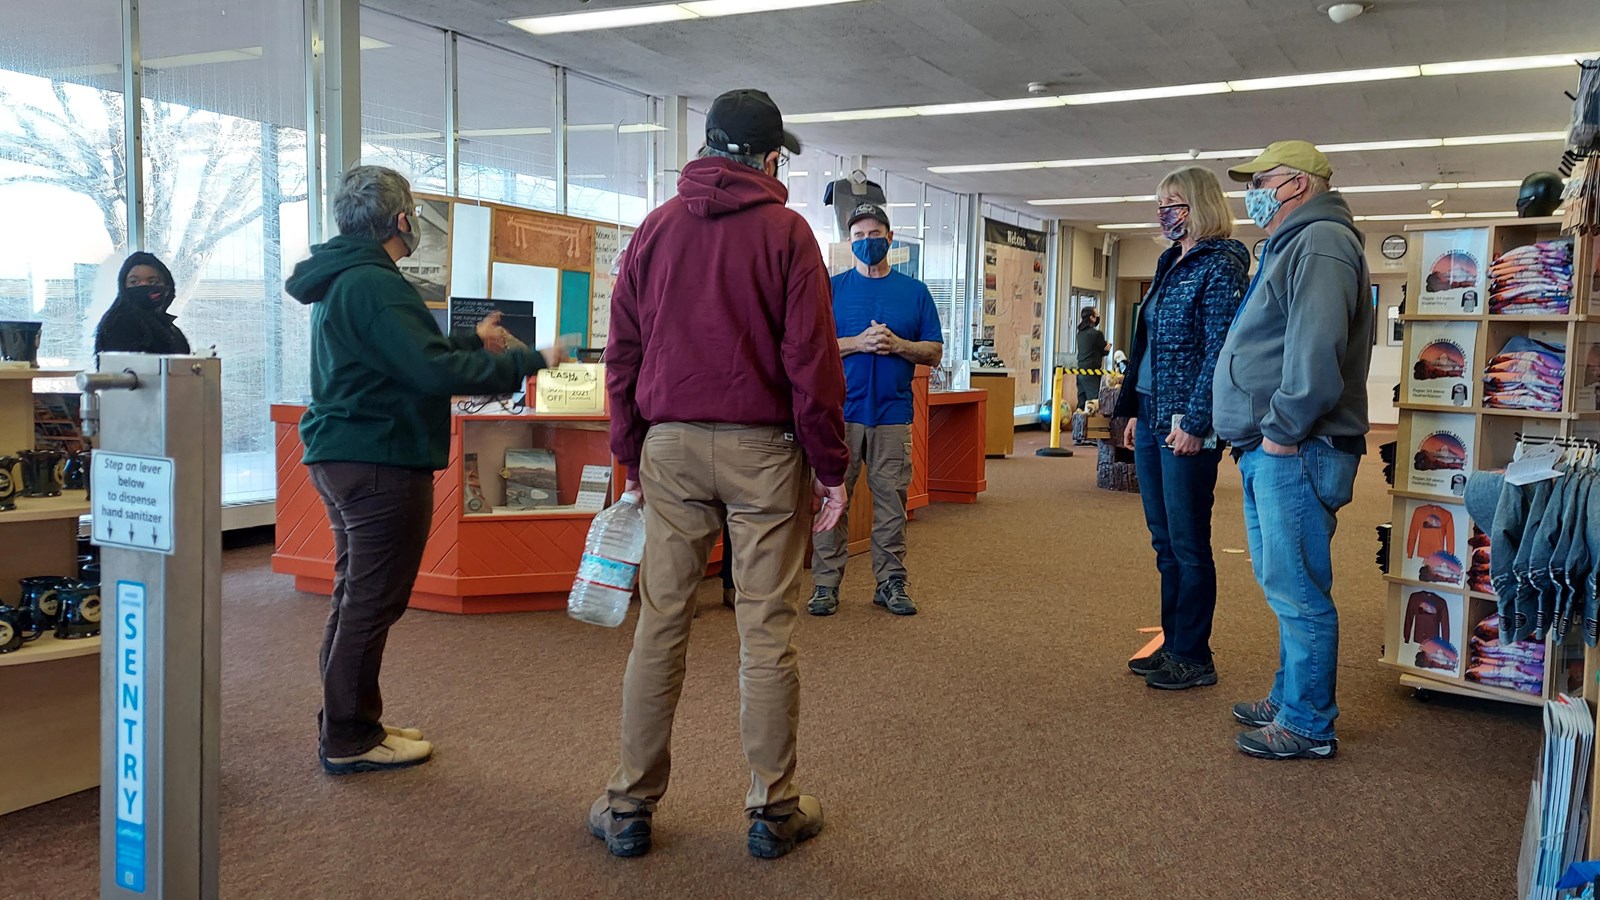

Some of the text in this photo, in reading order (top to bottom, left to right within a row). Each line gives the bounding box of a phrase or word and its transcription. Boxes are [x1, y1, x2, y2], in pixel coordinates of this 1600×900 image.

[104, 458, 162, 474] Step on lever
[118, 475, 145, 488] below
[108, 492, 156, 506] to dispense
[102, 504, 162, 524] hand sanitizer
[123, 613, 139, 814] SENTRY
